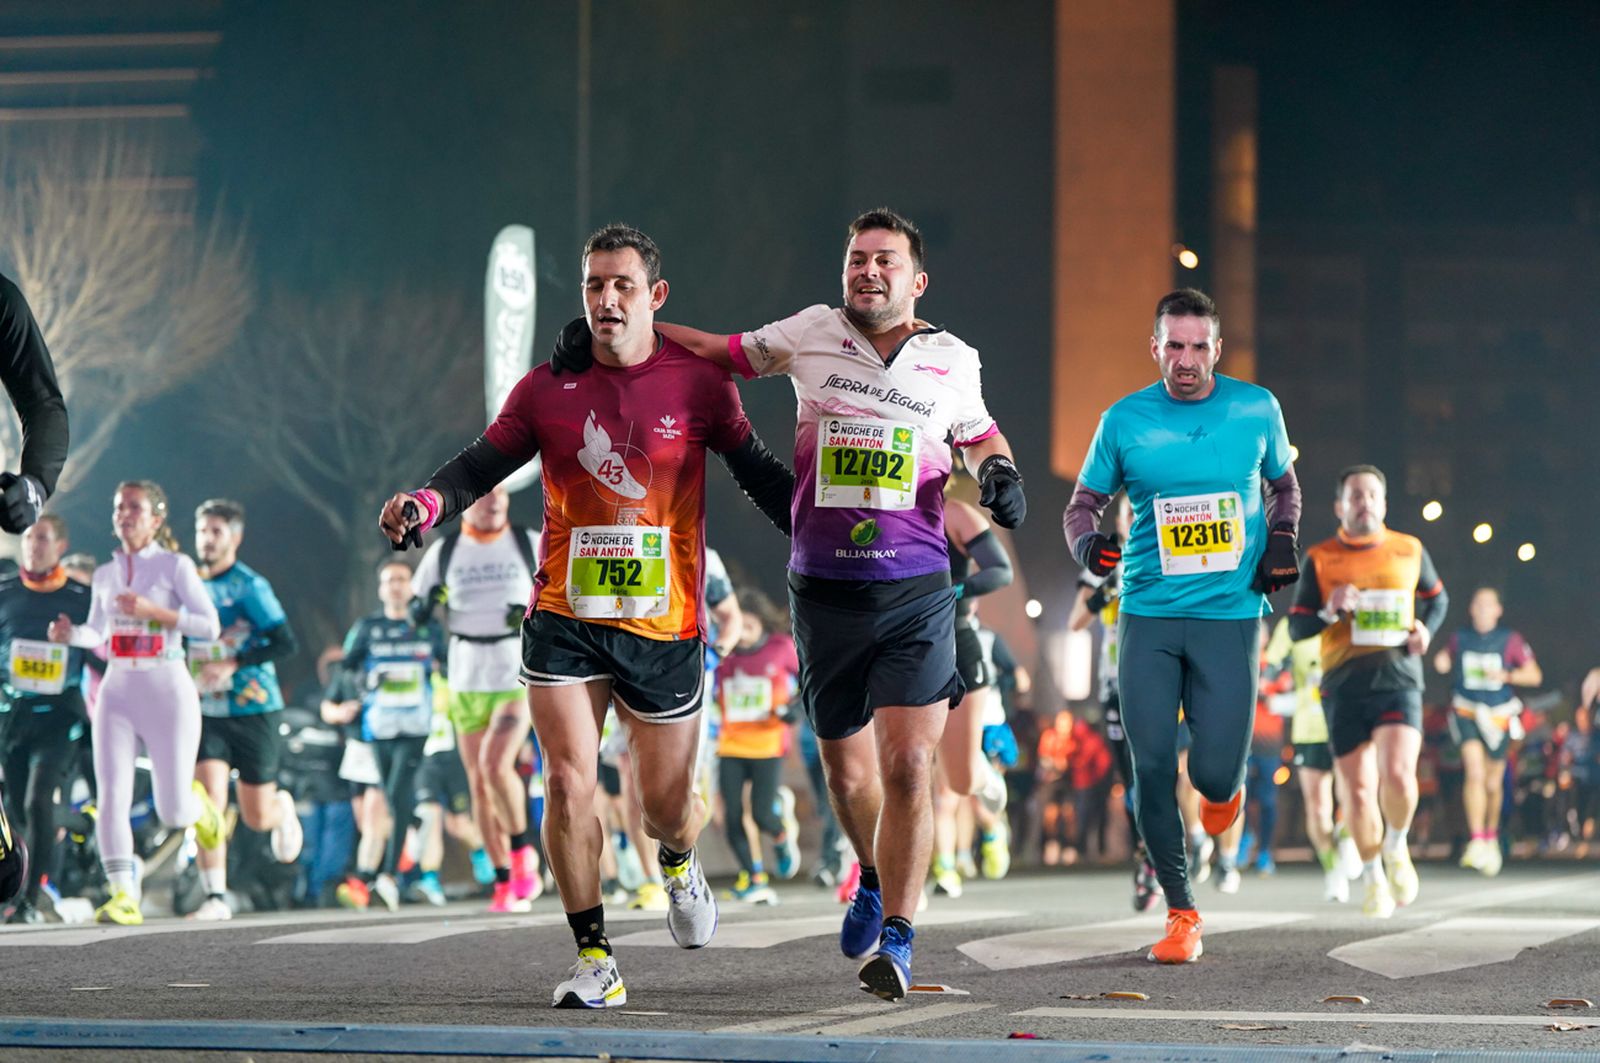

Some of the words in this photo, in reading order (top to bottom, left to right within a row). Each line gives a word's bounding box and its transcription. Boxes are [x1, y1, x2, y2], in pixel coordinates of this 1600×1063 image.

[820, 373, 869, 395] SIERRA
[870, 386, 883, 398] DE
[879, 388, 934, 418] SEGURA
[840, 426, 870, 437] NOCHE
[872, 428, 884, 438] DE
[828, 436, 848, 447] SAN
[849, 436, 884, 449] ANTÓN
[832, 448, 904, 481] 12792
[597, 459, 624, 485] 43
[1174, 504, 1199, 514] NOCHE
[1200, 503, 1210, 512] DE
[1166, 515, 1182, 525] SAN
[1183, 512, 1212, 524] ANTÓN
[1169, 520, 1233, 548] 12316
[591, 536, 620, 546] NOCHE
[622, 536, 634, 546] DE
[579, 547, 599, 557] SAN
[600, 545, 634, 557] ANTÓN
[835, 548, 898, 559] BUJARKAY
[596, 559, 642, 587] 752
